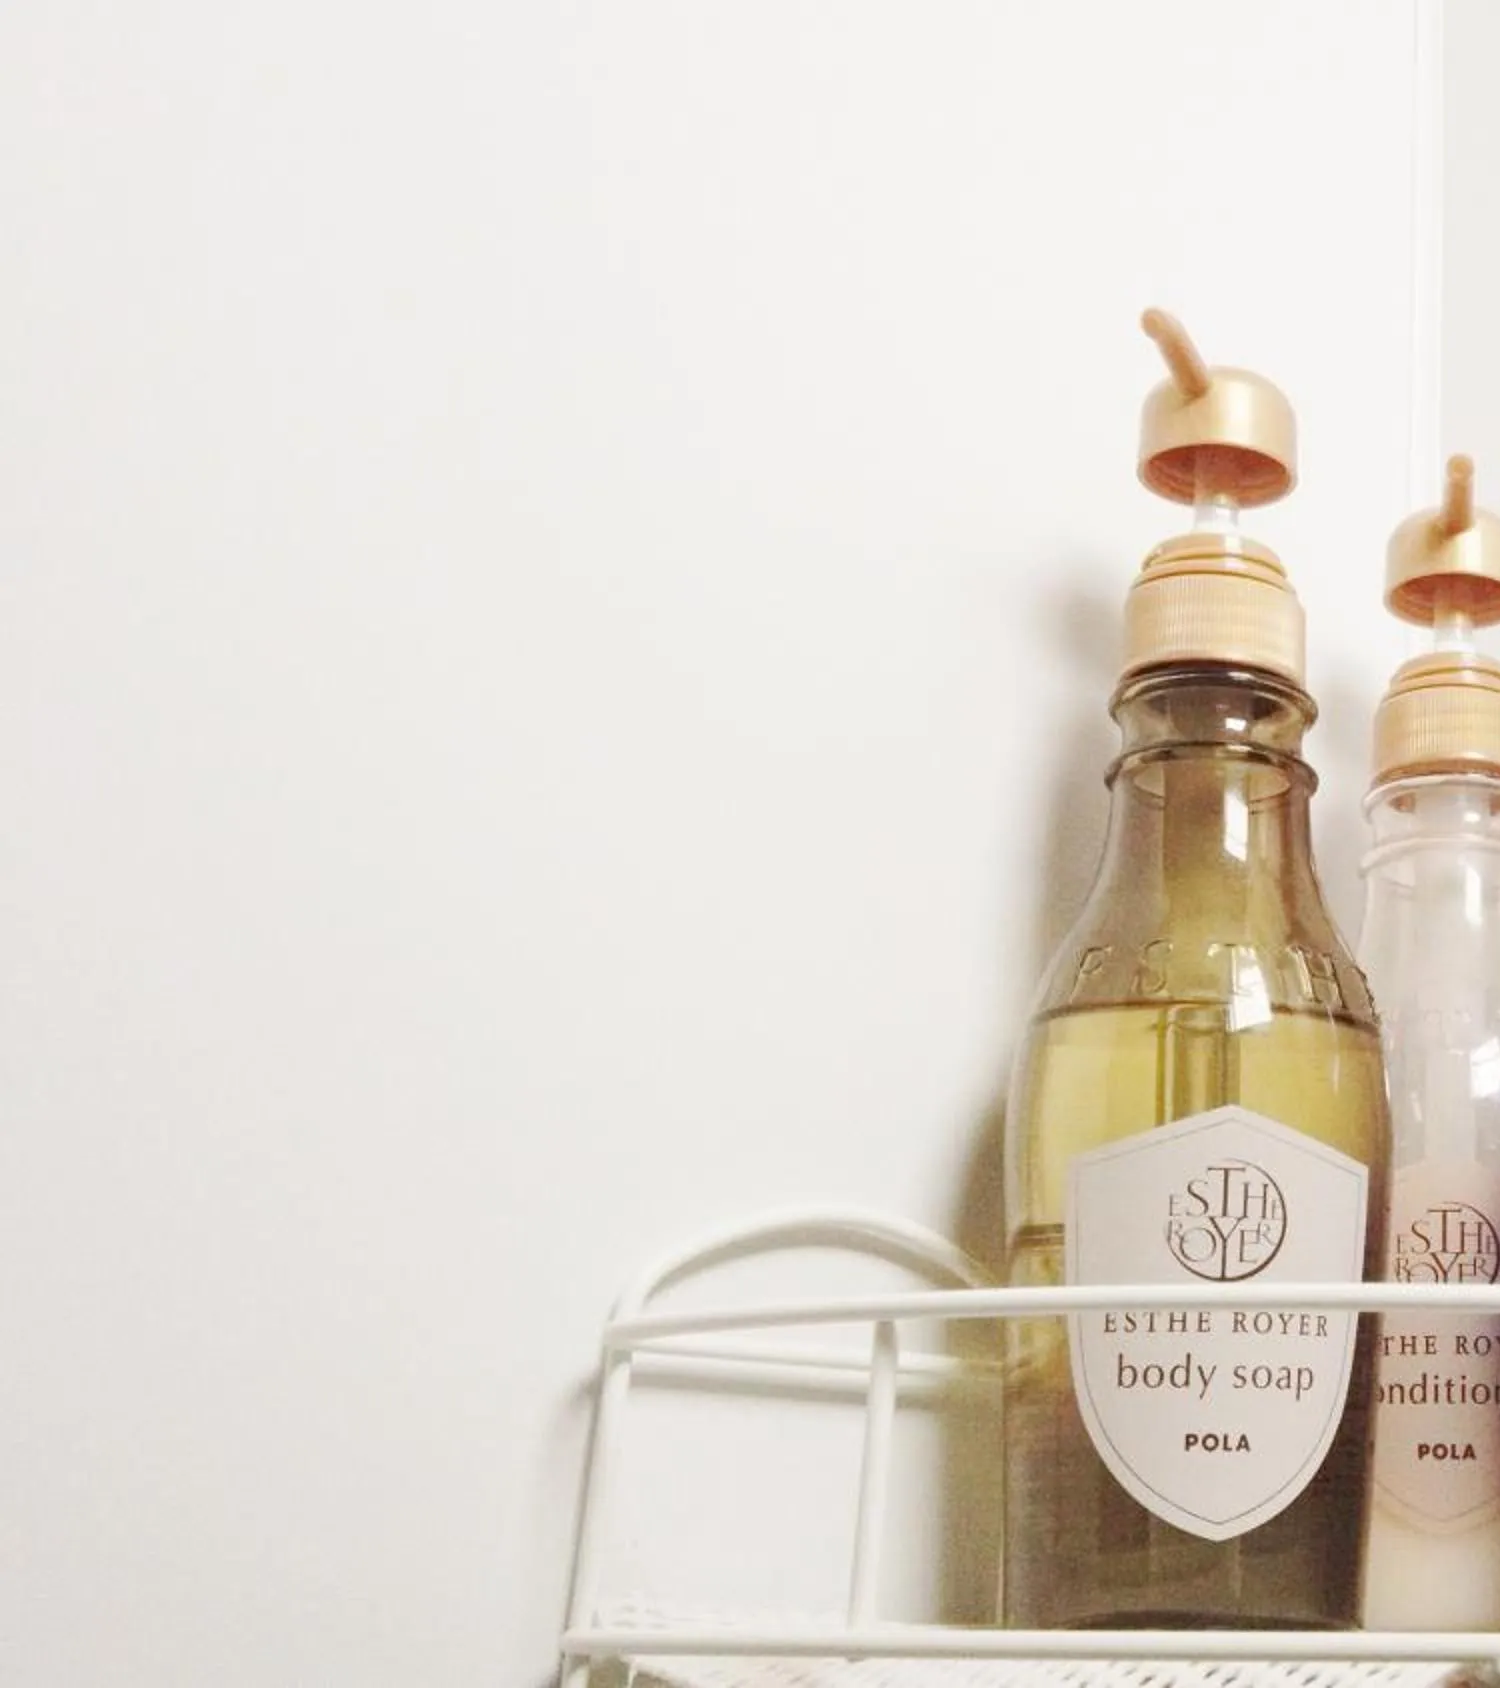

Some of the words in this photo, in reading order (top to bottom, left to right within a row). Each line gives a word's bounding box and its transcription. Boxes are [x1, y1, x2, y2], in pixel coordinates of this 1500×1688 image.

[1103, 1311, 1212, 1334] ESTHE
[1231, 1311, 1329, 1338] ROYER
[1380, 1335, 1438, 1357] THE
[1117, 1352, 1218, 1399] body
[1231, 1364, 1315, 1401] soap
[1184, 1433, 1251, 1453] POLA
[1416, 1443, 1477, 1461] POLA
